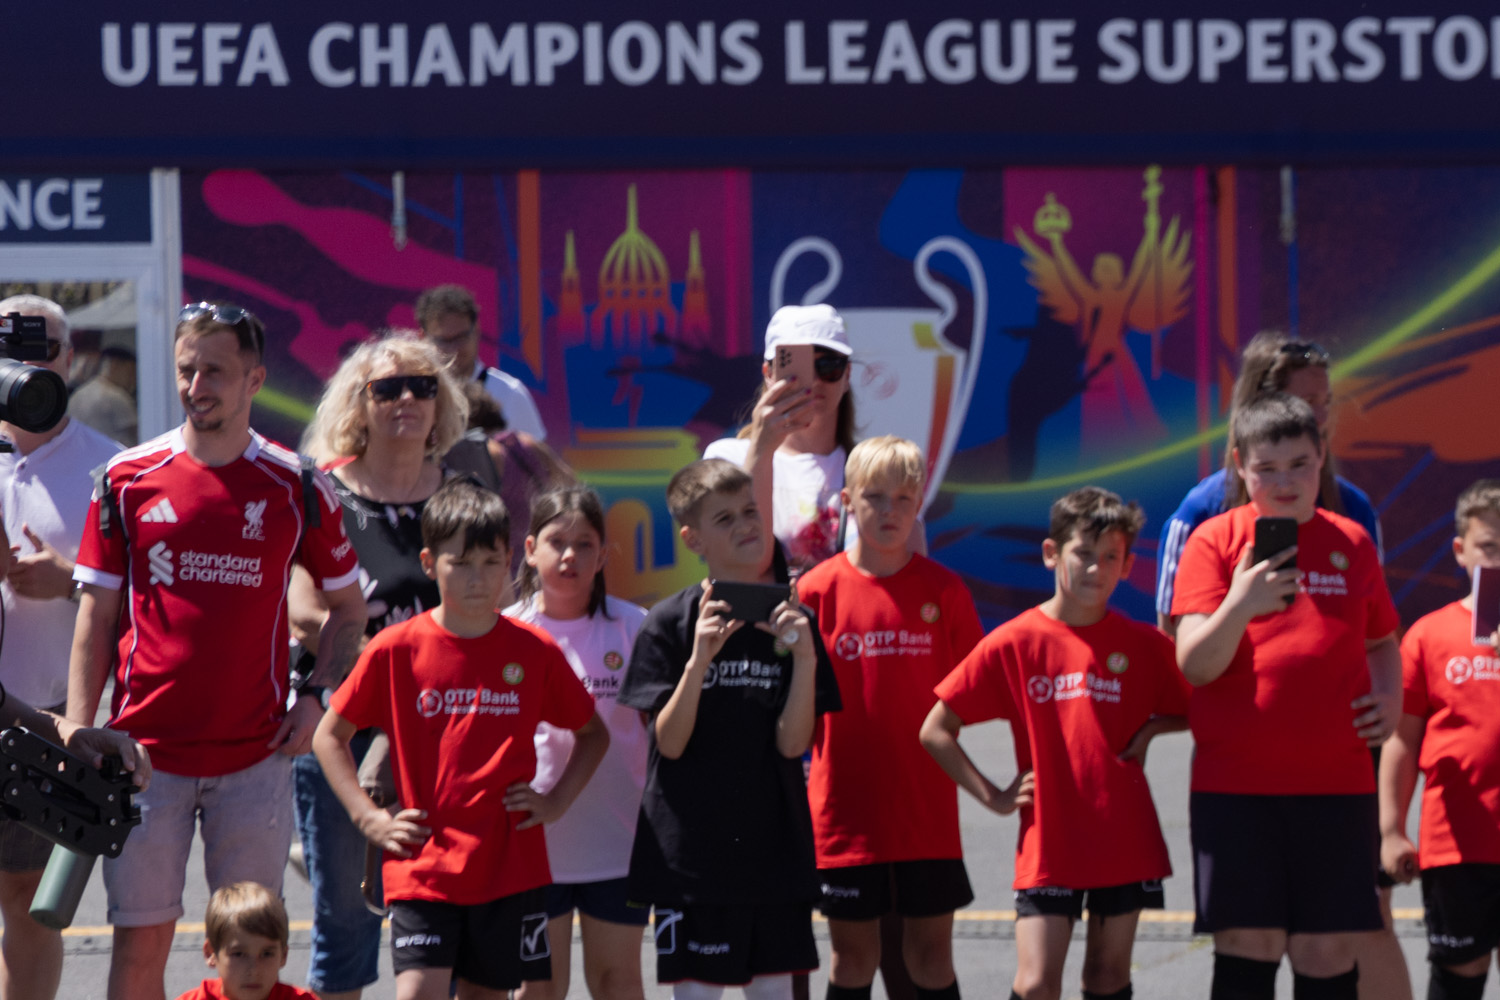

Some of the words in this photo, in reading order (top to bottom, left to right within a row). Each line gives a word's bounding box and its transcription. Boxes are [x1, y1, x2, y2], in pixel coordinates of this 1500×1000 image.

[101, 22, 291, 87] UEFA
[307, 20, 762, 88] CHAMPIONS
[786, 19, 1078, 85] LEAGUE
[179, 549, 261, 572] standard
[179, 565, 263, 588] chartered
[1308, 571, 1346, 588] Bank
[864, 630, 896, 647] OTP
[898, 629, 932, 646] Bank
[718, 660, 749, 676] OTP
[1054, 672, 1083, 691] OTP
[1086, 672, 1122, 693] Bank
[444, 688, 477, 702] OTP
[481, 688, 520, 705] Bank
